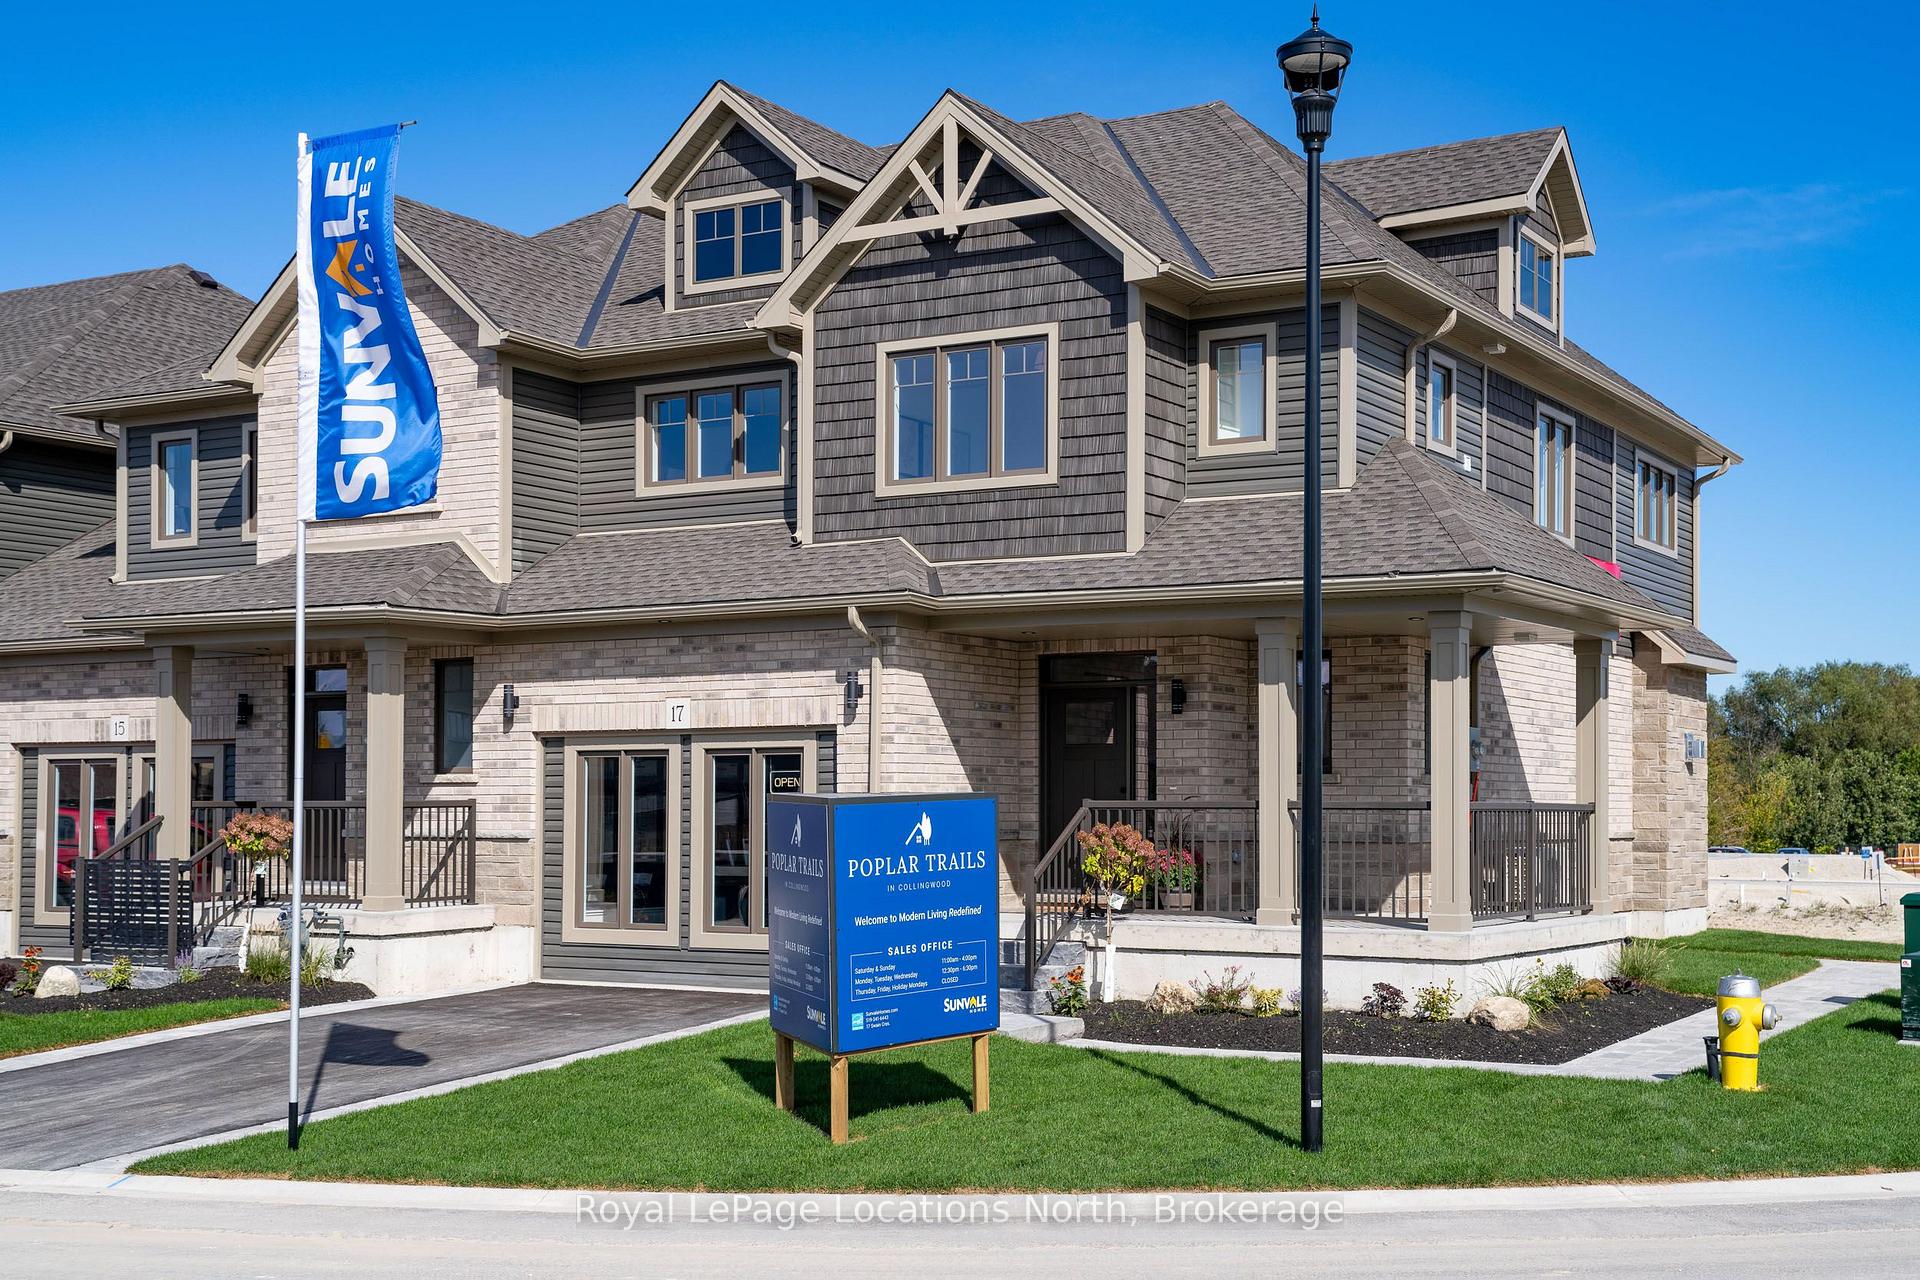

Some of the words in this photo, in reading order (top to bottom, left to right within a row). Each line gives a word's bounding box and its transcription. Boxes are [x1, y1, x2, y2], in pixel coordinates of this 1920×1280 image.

[358, 156, 385, 296] HOMES
[671, 705, 684, 722] 17
[114, 721, 125, 736] 15
[774, 777, 800, 787] OPEN
[771, 852, 797, 873] POPLAR
[799, 856, 824, 878] TRAILS
[848, 855, 920, 878] POPLAR
[926, 850, 986, 872] TRAILS
[887, 884, 895, 892] IN
[898, 879, 951, 892] COLLINGWOOD
[854, 915, 888, 927] Welcome
[890, 913, 897, 923] to
[899, 911, 926, 923] Modern
[927, 908, 948, 920] Living
[949, 904, 982, 918] Redefined
[784, 940, 797, 952] SALES
[797, 943, 811, 956] OFFICE
[887, 943, 917, 956] SALES
[920, 940, 953, 953] OFFICE
[854, 966, 875, 975] Saturday
[879, 964, 896, 972] Sunday
[894, 971, 918, 981] Wednesday
[892, 983, 908, 991] Holiday
[908, 981, 929, 989] Mondays
[941, 976, 959, 985] CLOSED
[943, 994, 987, 1013] SUNVALE
